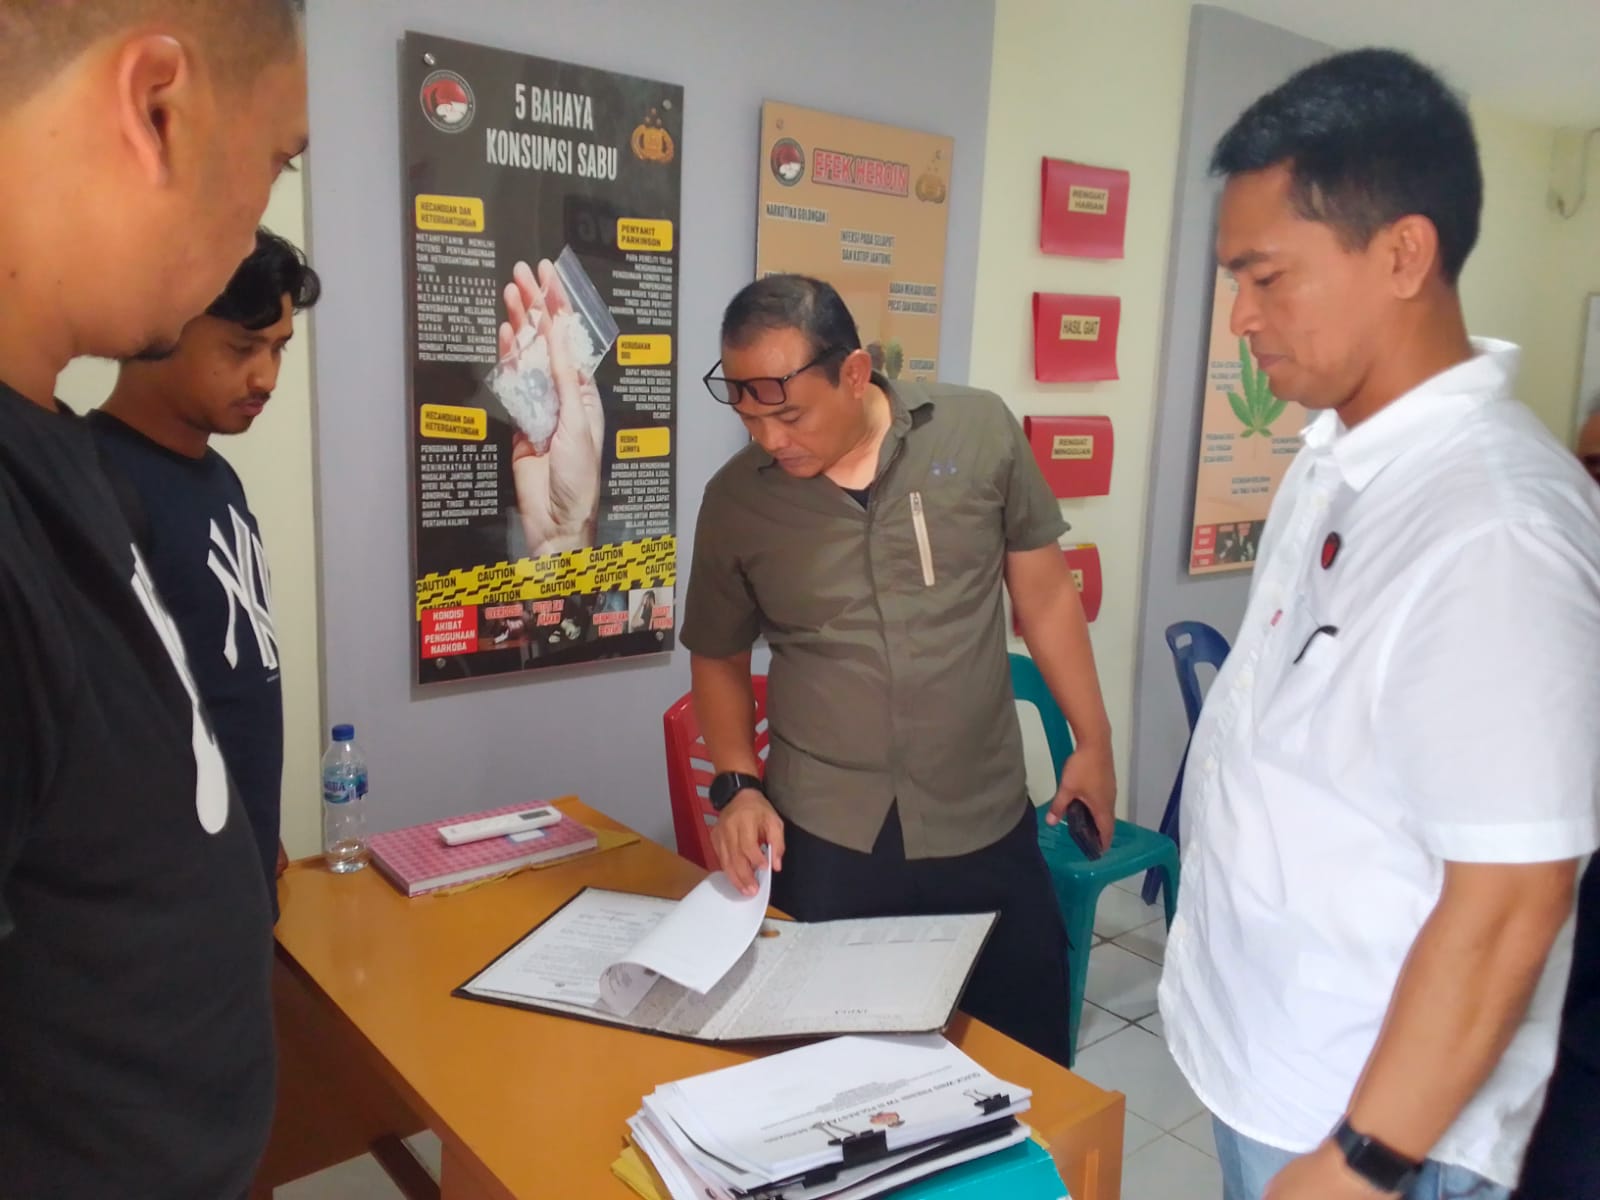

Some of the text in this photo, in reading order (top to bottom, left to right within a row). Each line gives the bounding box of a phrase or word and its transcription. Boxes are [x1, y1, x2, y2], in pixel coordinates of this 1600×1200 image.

[515, 84, 525, 119] 5
[531, 89, 593, 131] BAHAYA
[486, 128, 617, 180] KONSUMSI SABU
[815, 152, 907, 187] EFEK HEROIN
[766, 204, 796, 219] NARKOTIKA
[798, 207, 825, 222] GOLONGAN
[621, 235, 661, 247] PARKINSON
[417, 541, 673, 593] CAUTION CAUTION CAUTION CAUTION CAUTION
[483, 589, 520, 604] CAUTION
[540, 580, 576, 594] CAUTION
[594, 570, 628, 584] CAUTION
[433, 611, 464, 620] KONDISI
[434, 621, 462, 631] AKIBAT
[424, 631, 475, 644] PENGGUNAAN
[430, 643, 467, 654] NARKOBA
